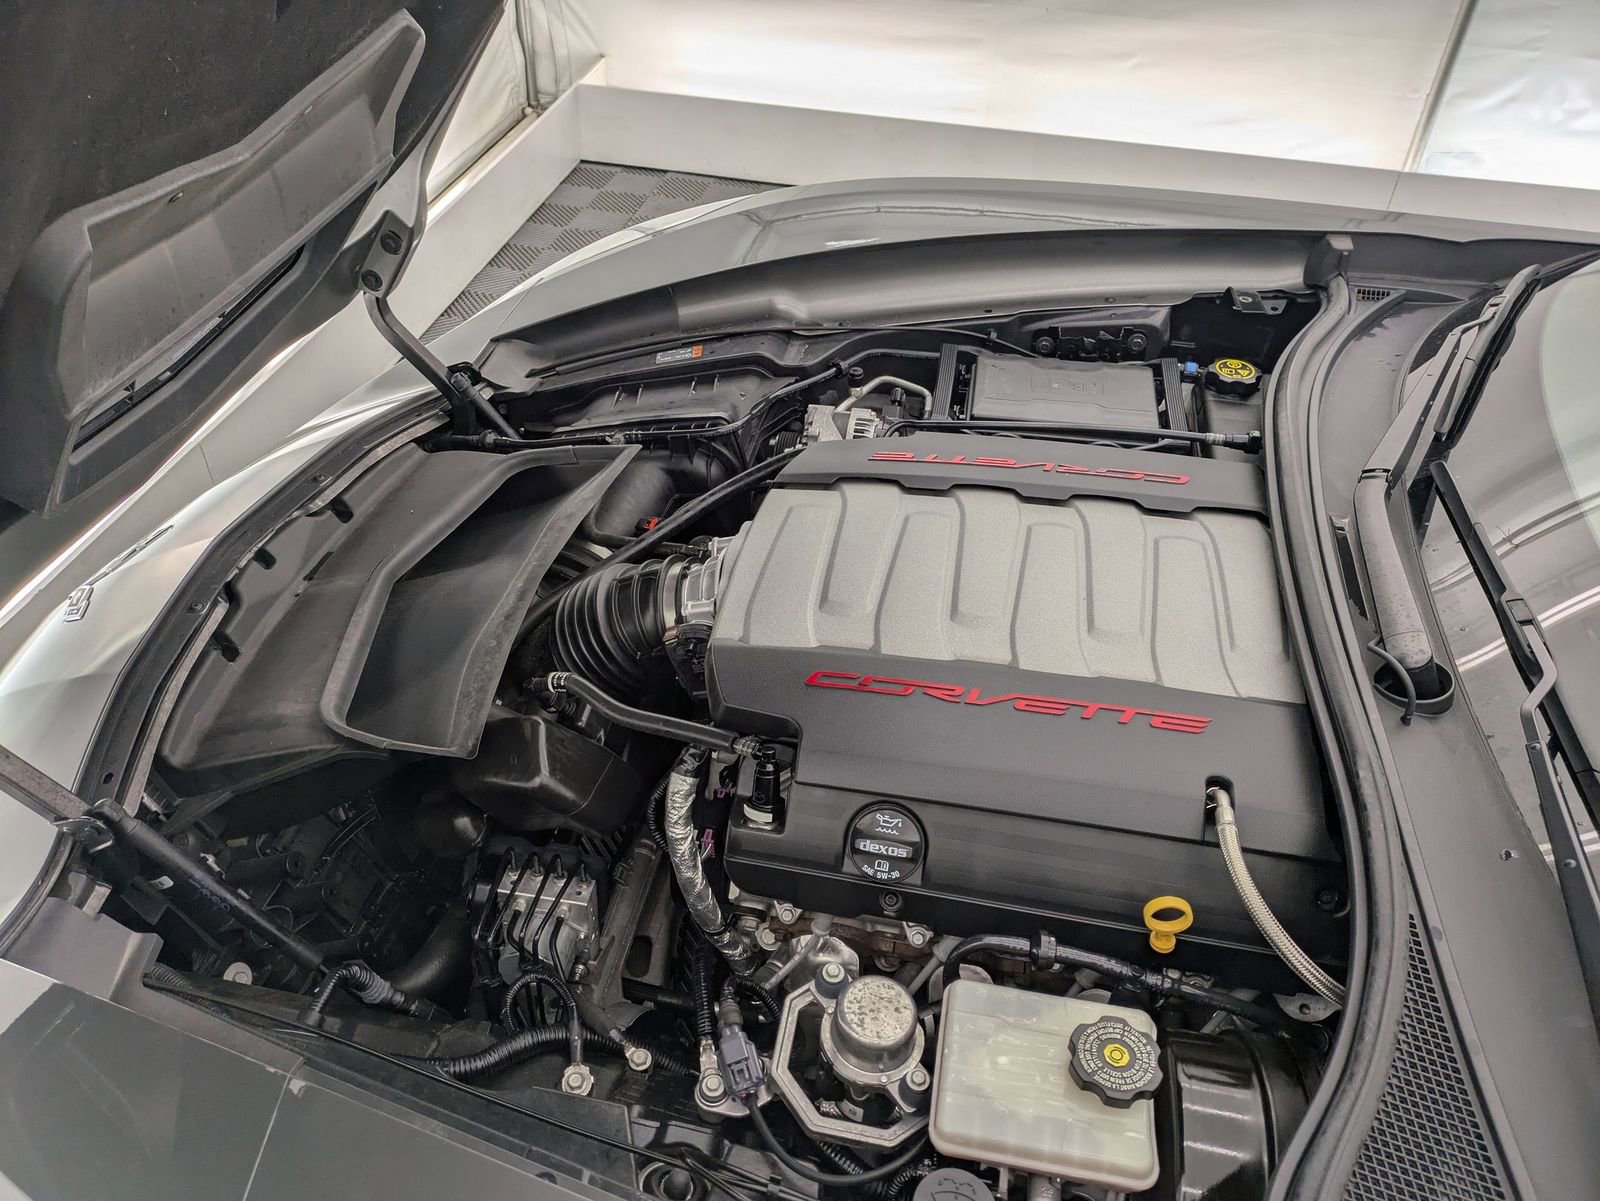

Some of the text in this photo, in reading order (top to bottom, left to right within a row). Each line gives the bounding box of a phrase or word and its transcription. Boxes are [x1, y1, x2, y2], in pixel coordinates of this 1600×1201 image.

[869, 451, 1191, 485] CORVETTE
[806, 671, 1212, 733] CORVETTE
[860, 840, 909, 857] dexos
[862, 864, 900, 879] SAE 5W-30
